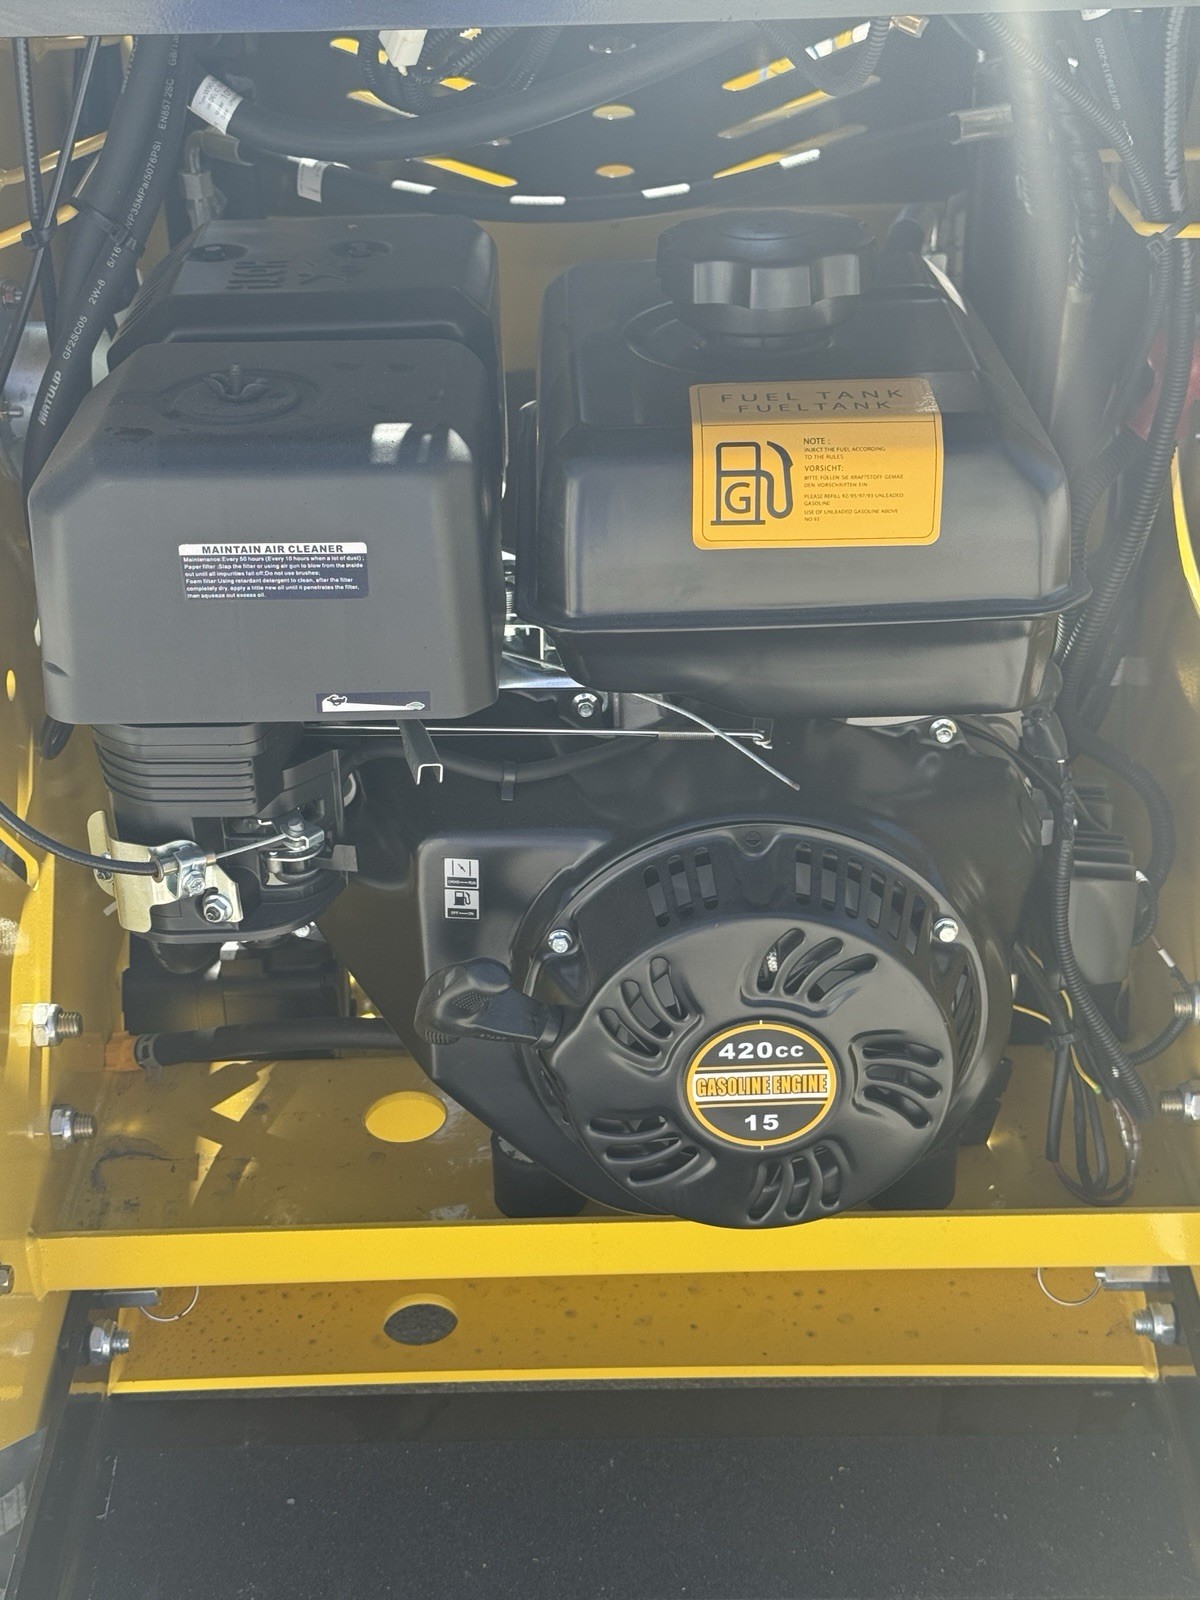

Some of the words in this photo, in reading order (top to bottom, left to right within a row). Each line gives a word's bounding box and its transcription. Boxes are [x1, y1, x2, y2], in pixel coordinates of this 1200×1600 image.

[37, 369, 63, 427] MATULIP
[62, 315, 88, 361] GF2SC05
[88, 278, 106, 305] 2W-8
[721, 392, 799, 403] FUEL
[816, 389, 903, 400] TANK
[738, 401, 891, 413] FUELTANK
[803, 437, 826, 445] NOTE
[804, 464, 844, 472] VORSICHT:
[724, 481, 751, 514] G
[201, 545, 262, 554] MAINTAIN
[264, 545, 286, 554] AIR
[288, 544, 344, 553] CLEANER
[718, 1041, 804, 1060] 420cc
[695, 1075, 771, 1097] GASOLINE
[771, 1074, 828, 1095] ENGINE
[744, 1113, 780, 1131] 15
